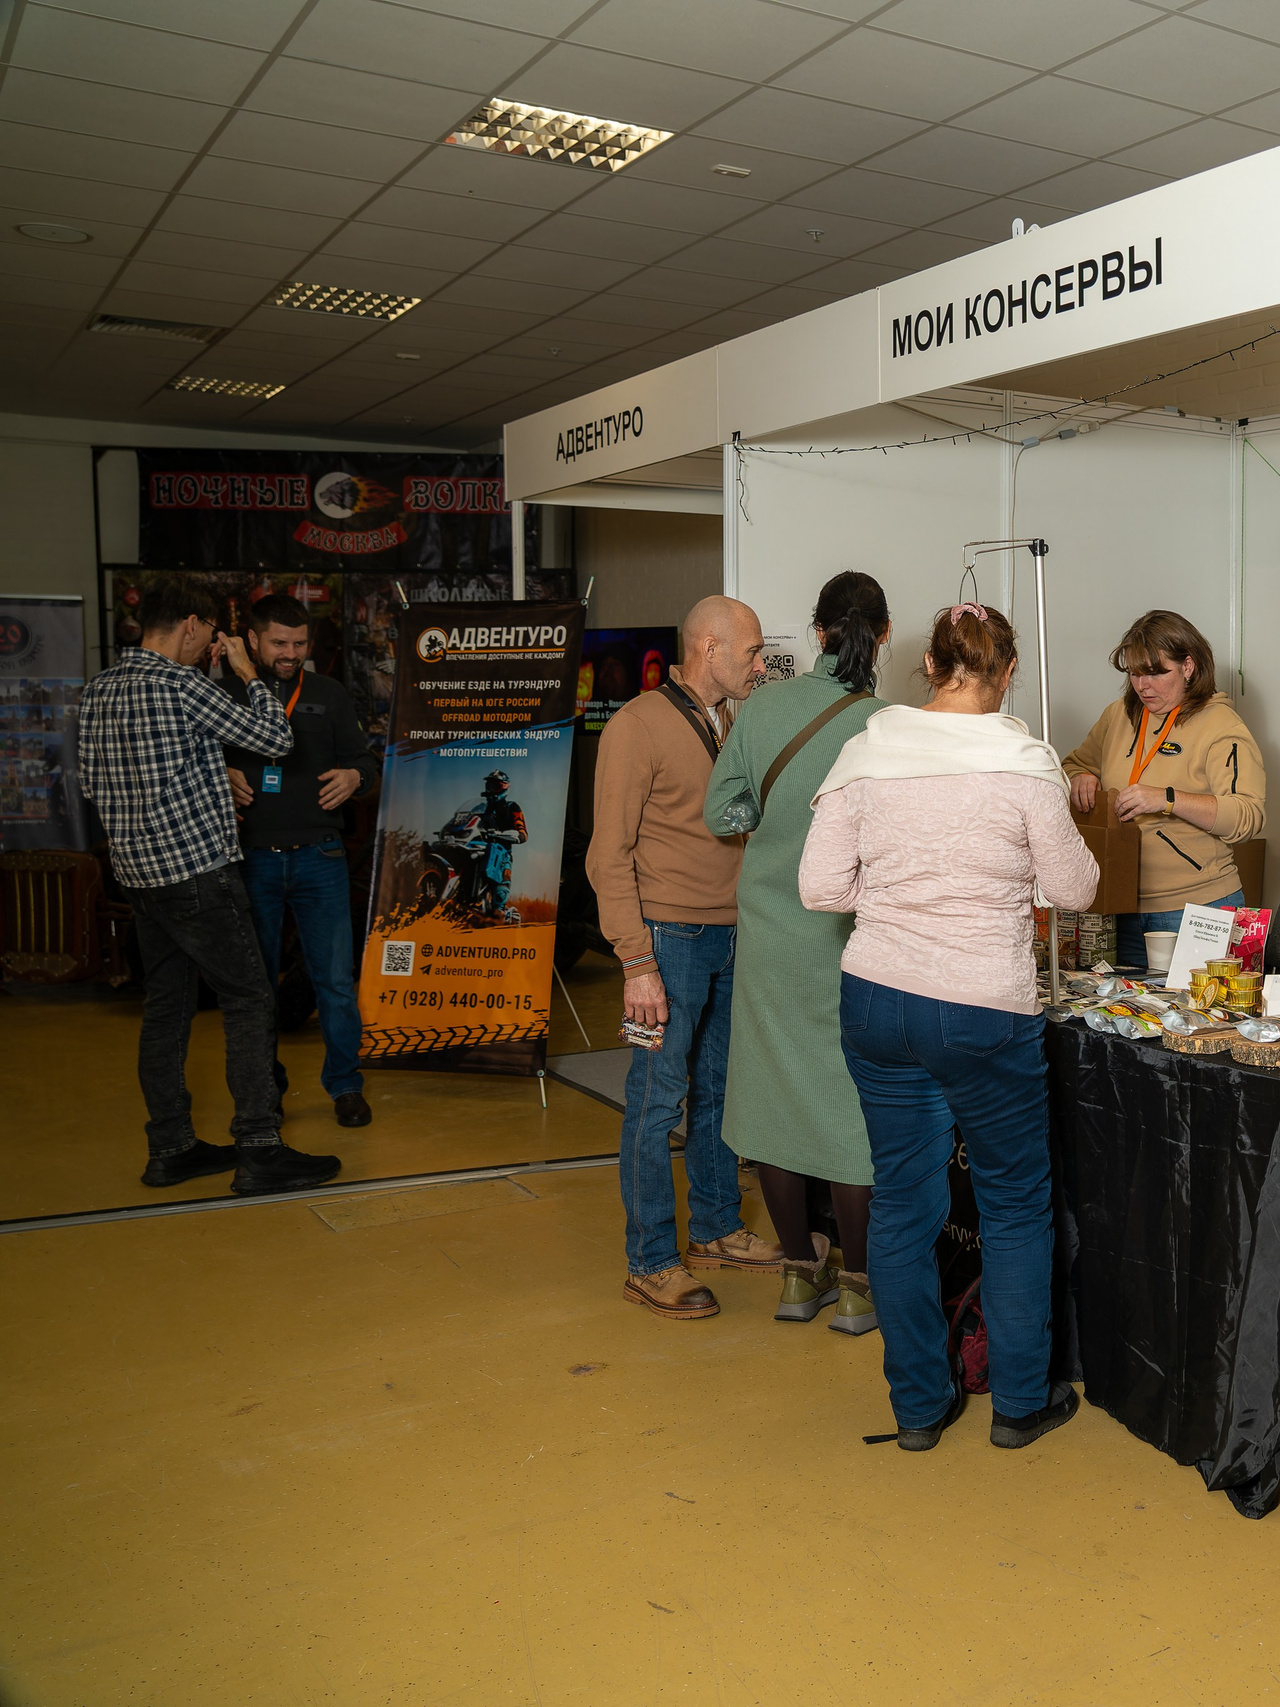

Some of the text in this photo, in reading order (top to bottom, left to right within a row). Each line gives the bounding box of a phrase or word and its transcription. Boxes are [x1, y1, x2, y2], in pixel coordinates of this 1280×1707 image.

[892, 237, 1163, 358] МОИ КОНСЕРВЫ
[556, 406, 643, 464] АДВЕНТУРО
[154, 474, 308, 509] НОЧНЫЕ
[302, 527, 398, 553] МОСКВА
[448, 625, 567, 651] АДВЕНТУРО
[446, 653, 487, 661] ВПЕЧАТЛЕНИЯ
[488, 653, 523, 661] ДОСТУПНЫЕ
[534, 652, 565, 660] КАЖДОМУ
[420, 680, 561, 691] ОБУЧЕНИЕ ЕЗДЕ НА ТУРЭНДУРО
[434, 696, 541, 707] ПЕРВЫЙ НА ЮГЕ РОССИИ
[442, 713, 532, 724] OFFROAD МОТОДРОМ
[410, 730, 560, 740] ПРОКАТ ТУРИСТИЧЕСКИХ ЭНДУРО
[440, 748, 528, 757] МОТОПУТЕШЕСТВИЯ
[1189, 920, 1229, 934] 8-926-782-87-50
[436, 946, 536, 960] ADVENTURO.PRO
[434, 966, 503, 978] adventuro_pro
[379, 990, 532, 1010] +7 (928) 440-00-15
